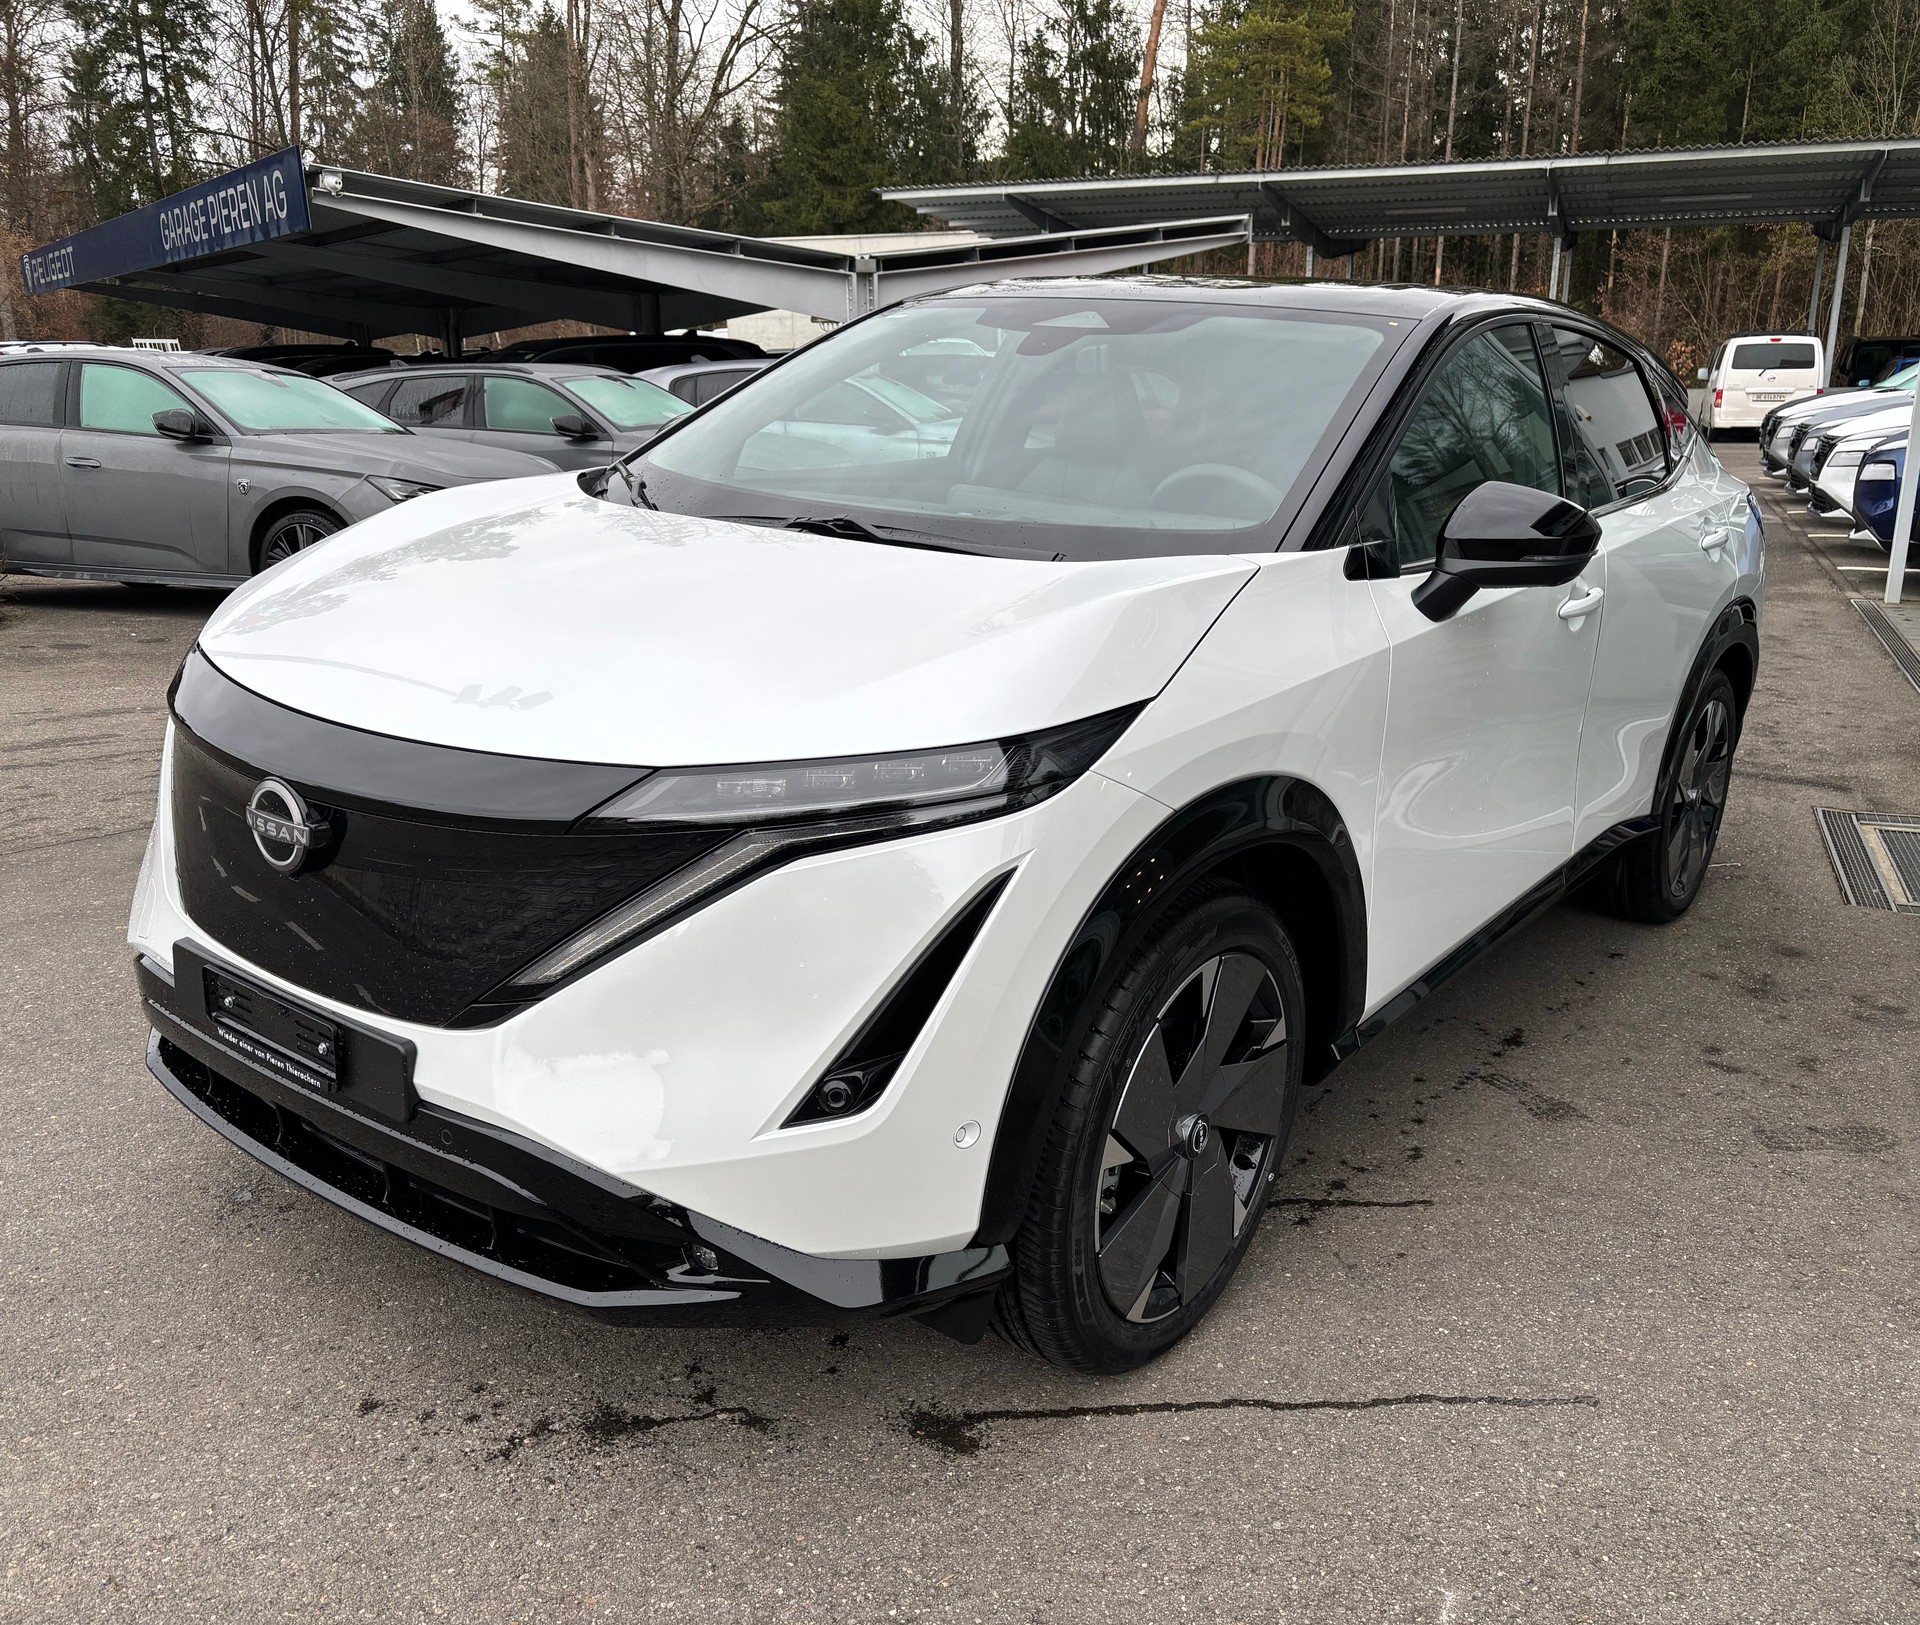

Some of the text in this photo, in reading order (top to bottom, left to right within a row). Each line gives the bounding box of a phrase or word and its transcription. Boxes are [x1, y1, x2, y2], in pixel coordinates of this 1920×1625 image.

[159, 169, 288, 251] GARAGE PIEREN AG
[31, 245, 76, 286] PEUGEOT
[246, 810, 307, 844] NISSAN
[217, 1026, 321, 1088] Wieder einer von Pieren Thierachern
